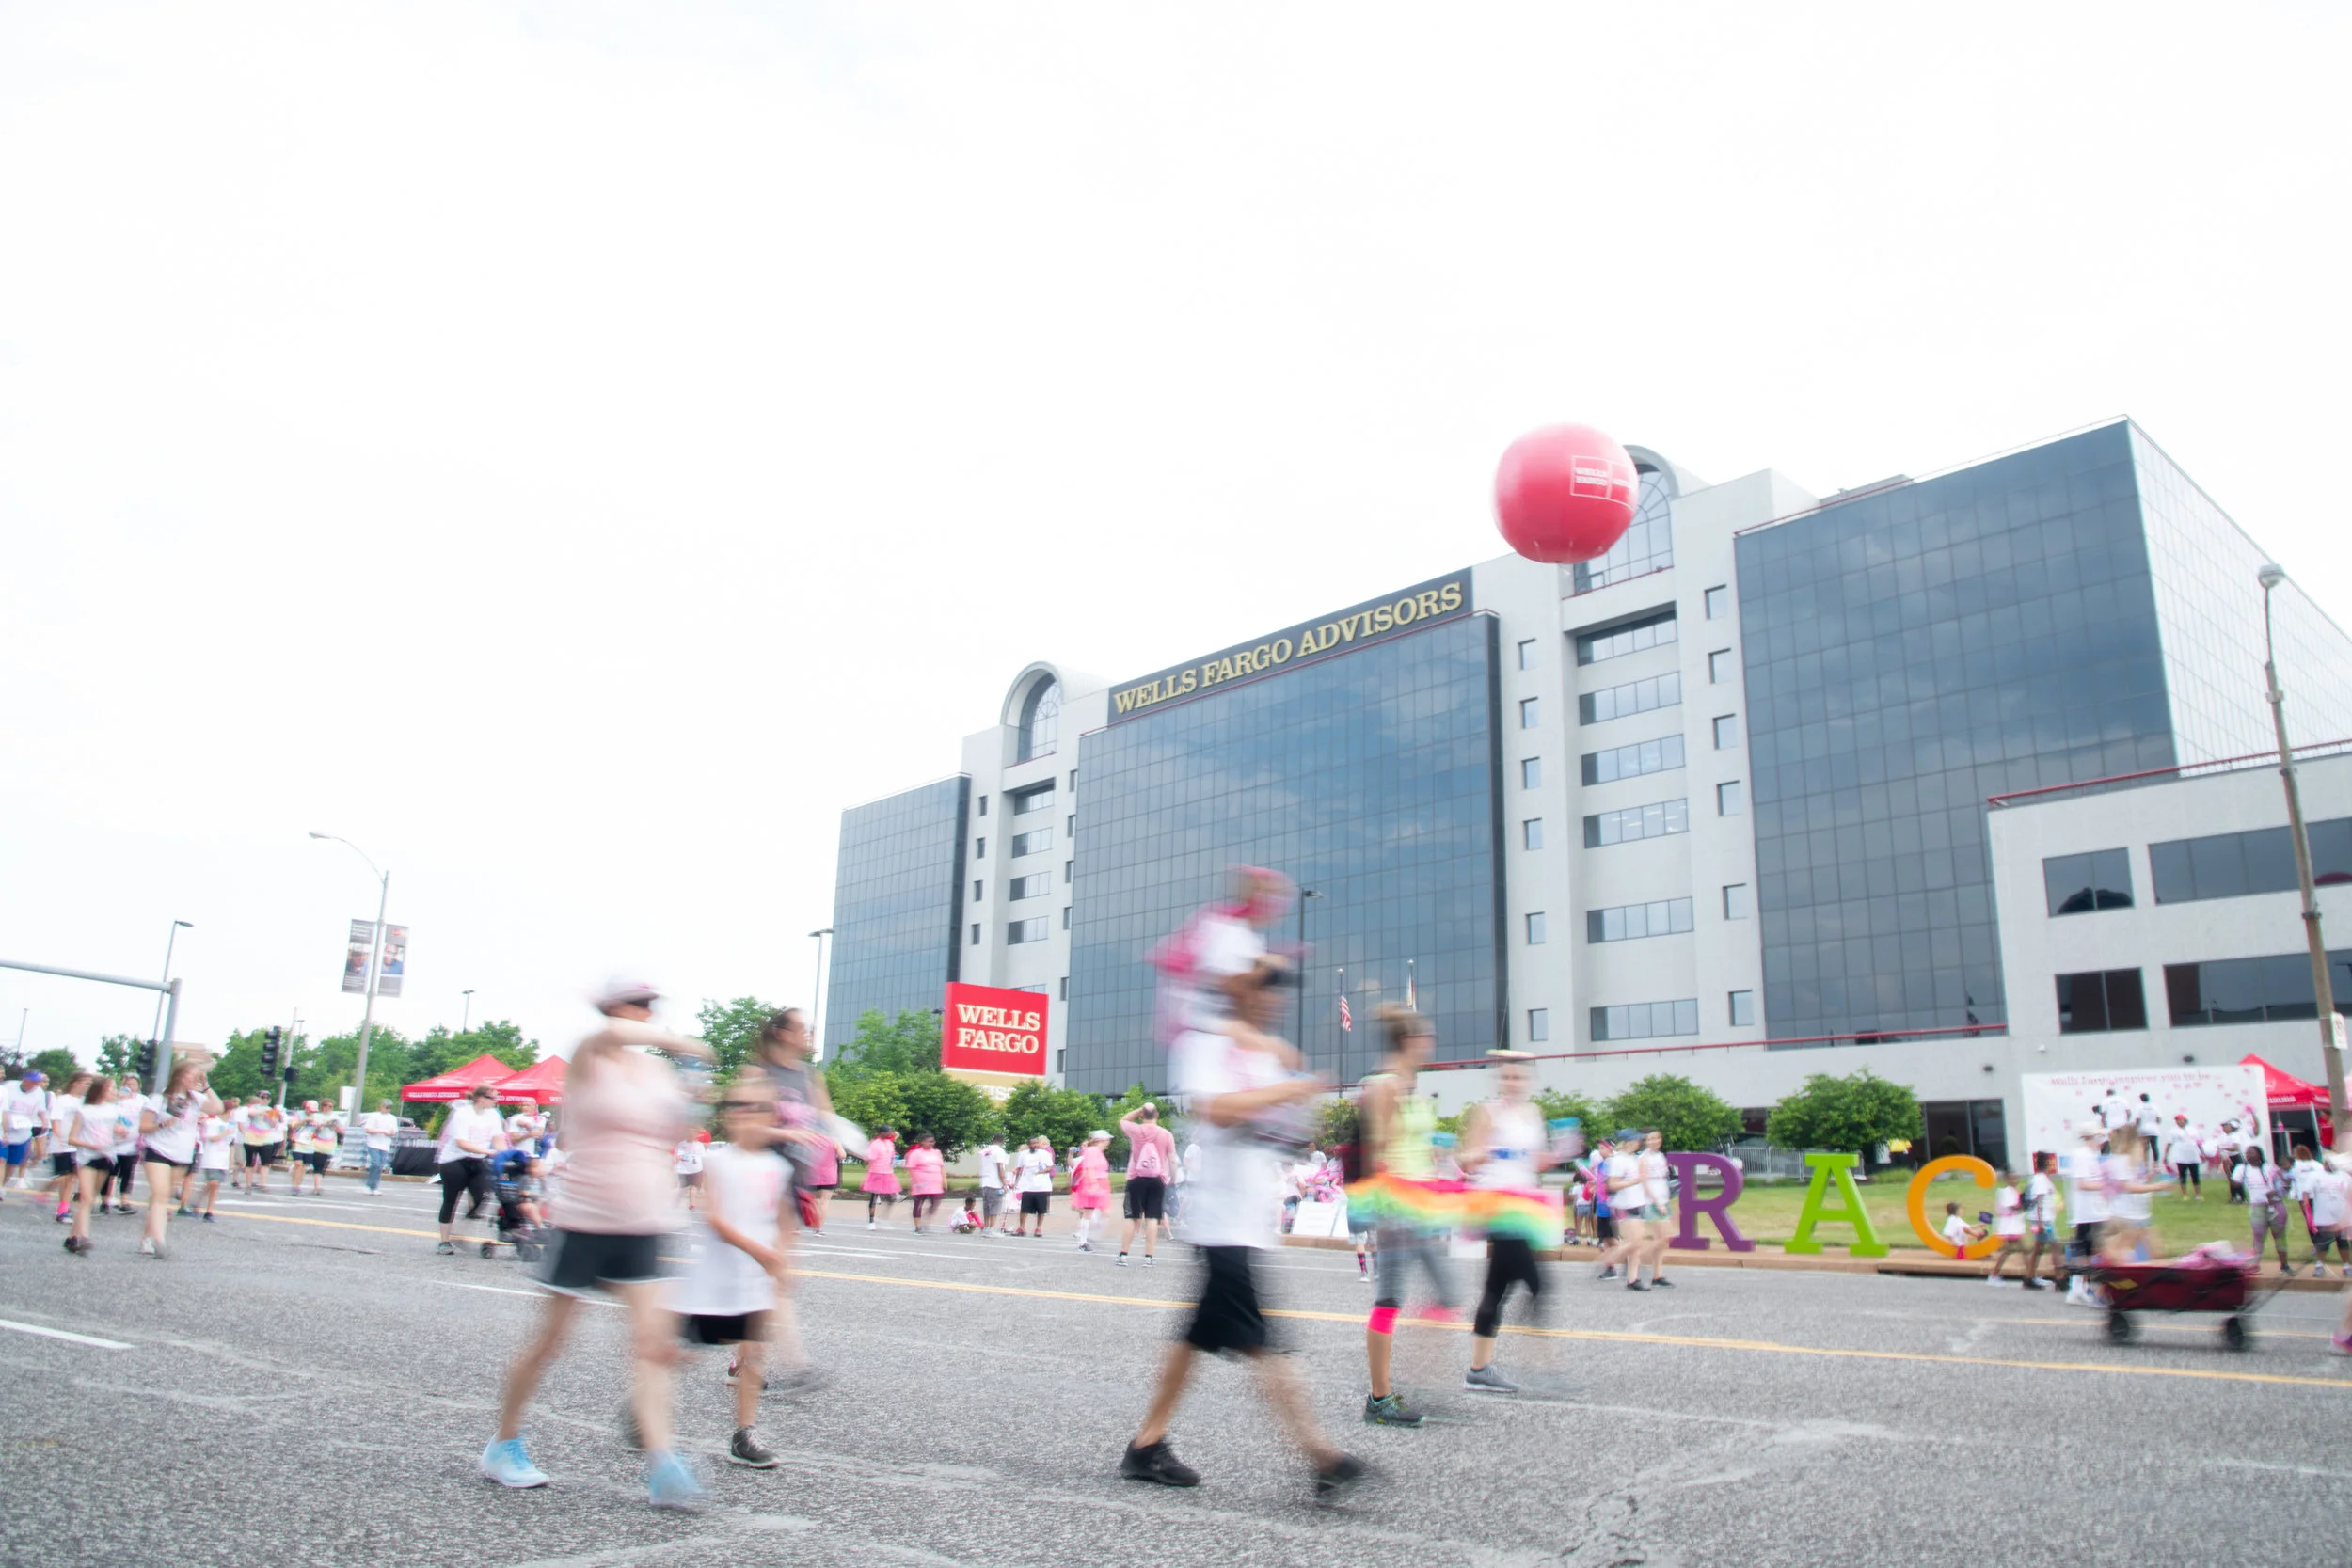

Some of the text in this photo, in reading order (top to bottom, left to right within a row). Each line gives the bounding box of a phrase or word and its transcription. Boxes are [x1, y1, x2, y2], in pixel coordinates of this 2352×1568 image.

[1114, 581, 1463, 715] WELLS FARGO ADVISORS
[956, 1003, 1041, 1032] WELLS
[956, 1027, 1039, 1054] FARGO
